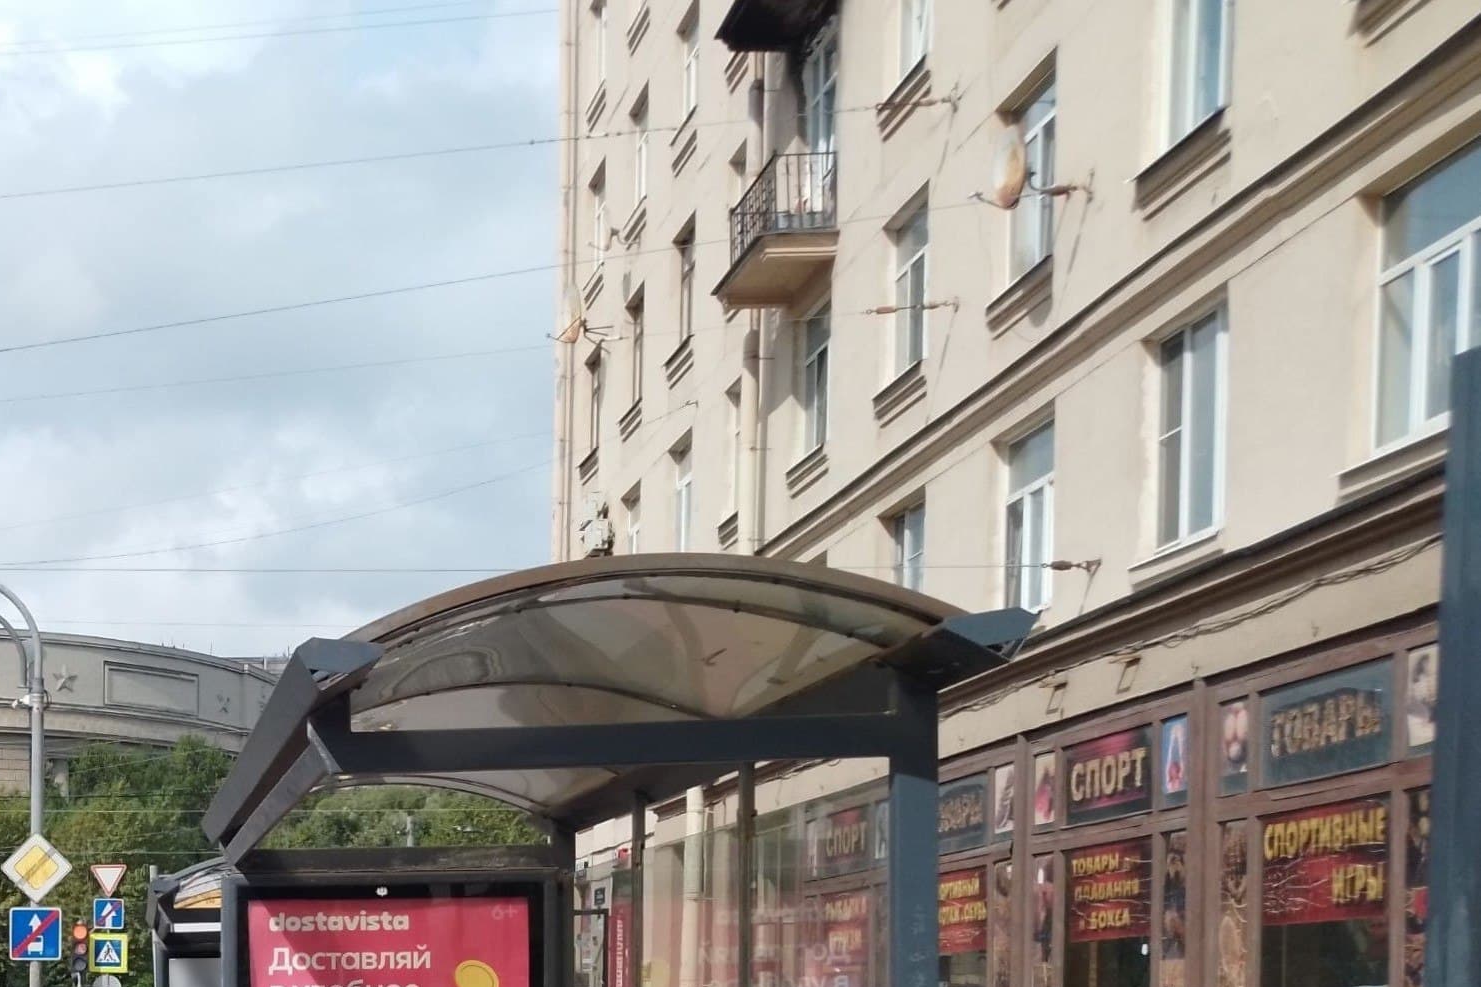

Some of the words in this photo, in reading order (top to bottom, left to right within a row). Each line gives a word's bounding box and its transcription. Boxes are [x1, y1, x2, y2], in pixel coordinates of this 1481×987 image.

[1071, 747, 1146, 802] СПОРТ
[826, 822, 868, 858] СПОРТ
[1264, 806, 1386, 861] СПОРТИВНЫЕ
[1071, 853, 1119, 875] ТОВАРЫ
[1332, 864, 1384, 904] ИГРЫ
[269, 911, 410, 932] dostavista
[491, 904, 518, 920] 6+
[269, 944, 431, 976] Доставляй
